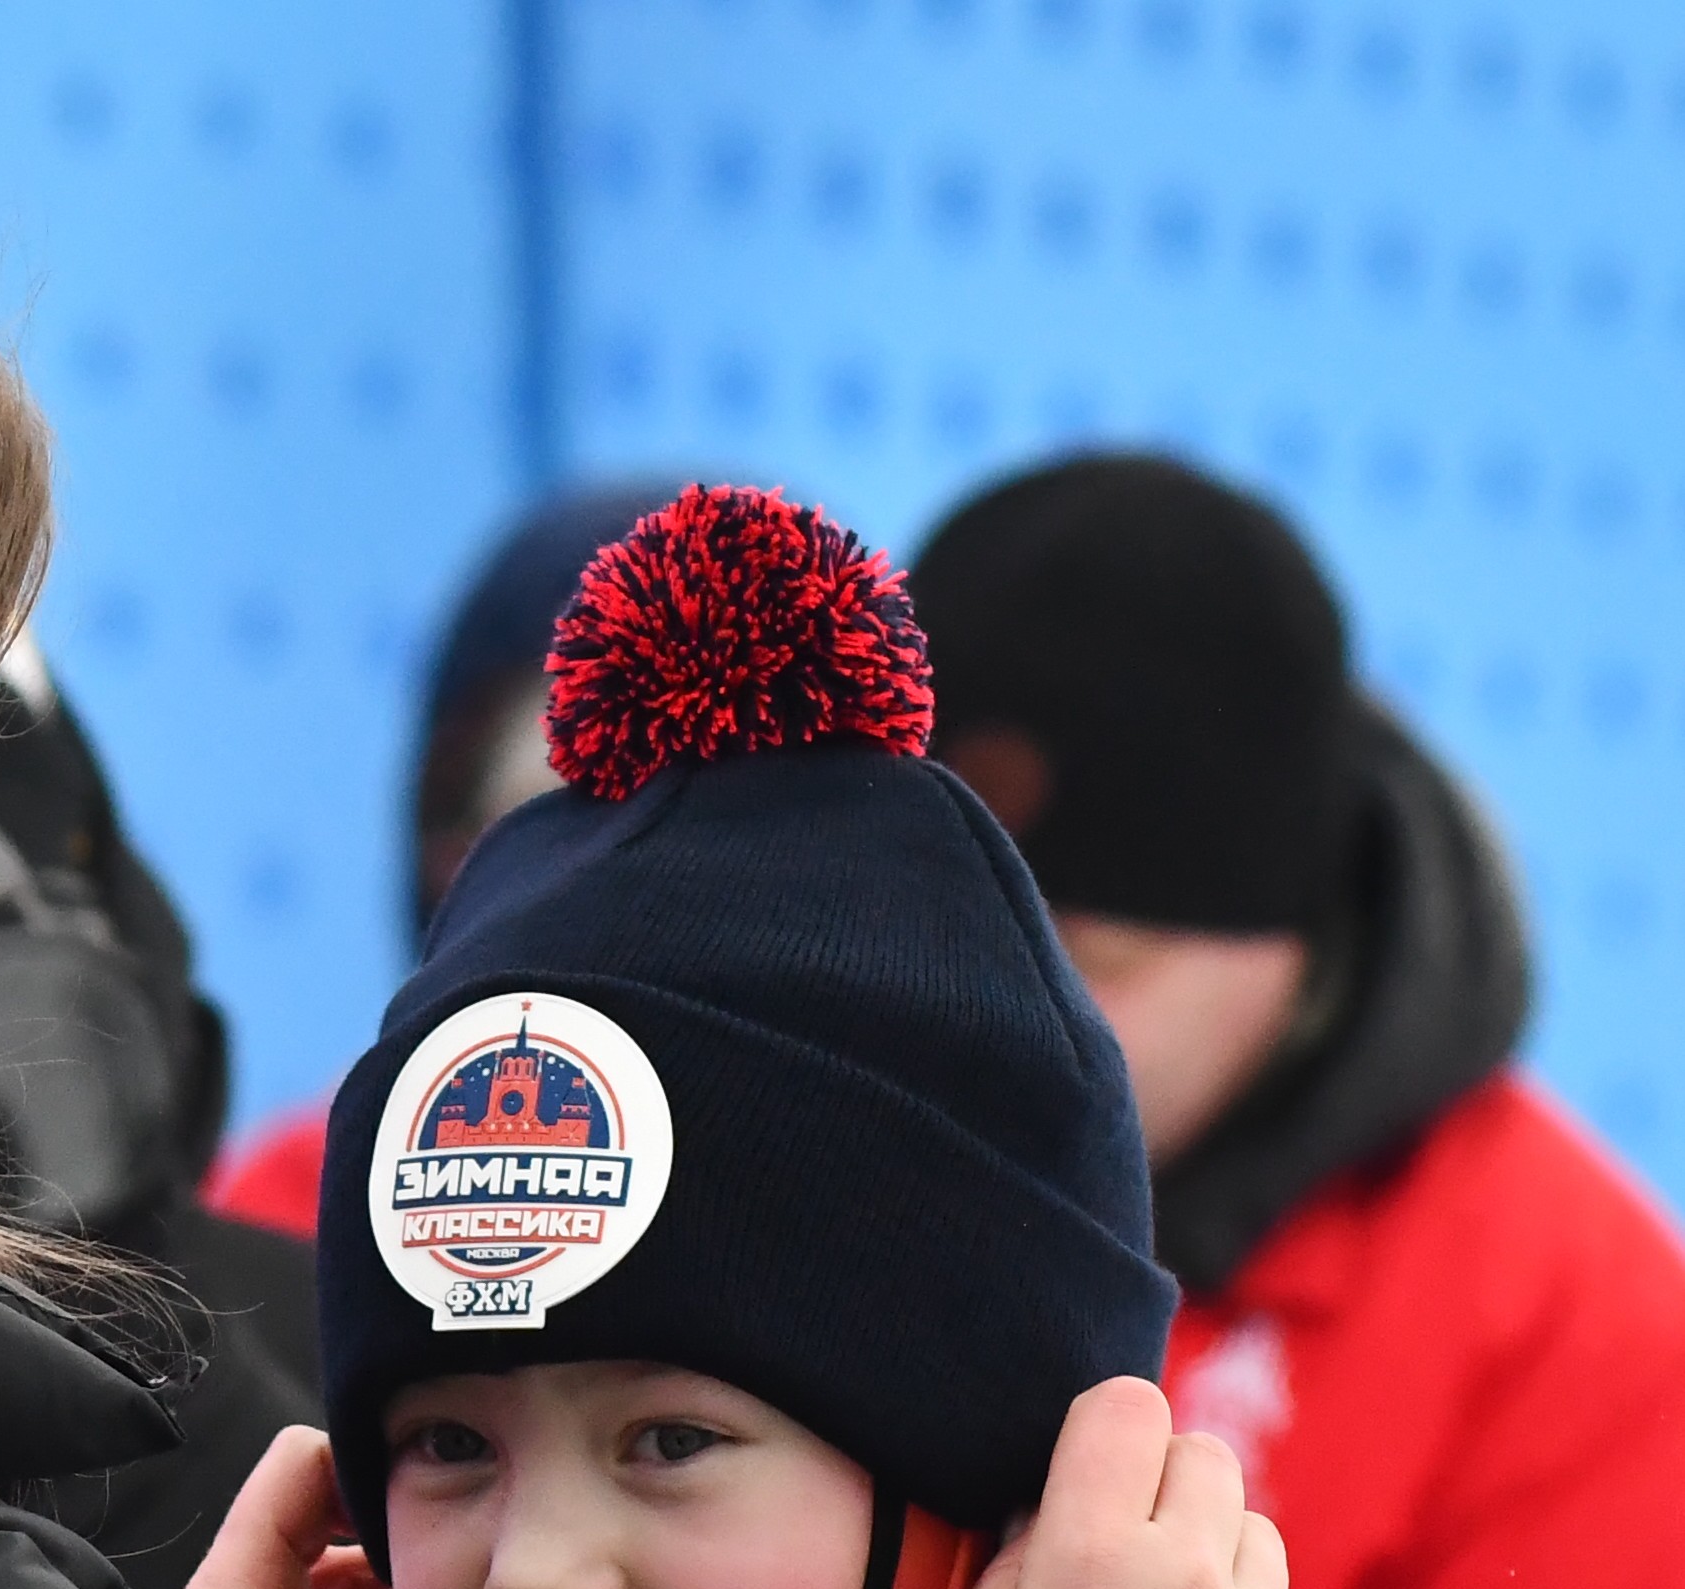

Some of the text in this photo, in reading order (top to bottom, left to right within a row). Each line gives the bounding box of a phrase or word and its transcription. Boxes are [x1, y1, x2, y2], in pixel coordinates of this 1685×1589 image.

[395, 1157, 626, 1201] ЗИМНЯЯ
[403, 1211, 603, 1242] КЛАССИКА
[466, 1248, 521, 1260] МОСКВА
[445, 1280, 532, 1315] ФХМ
